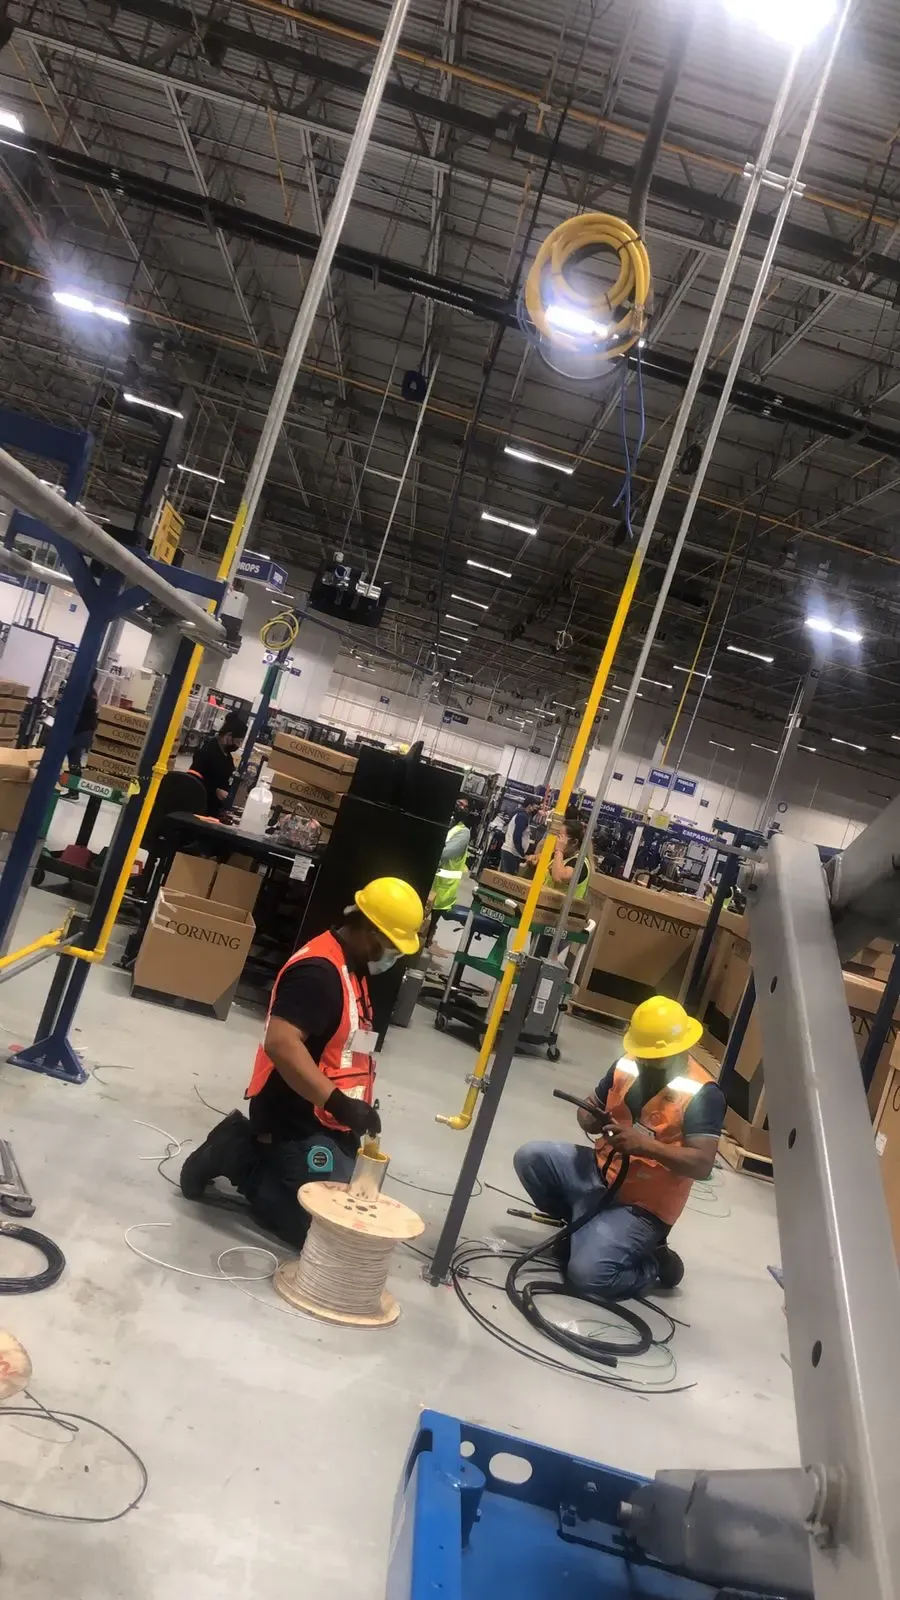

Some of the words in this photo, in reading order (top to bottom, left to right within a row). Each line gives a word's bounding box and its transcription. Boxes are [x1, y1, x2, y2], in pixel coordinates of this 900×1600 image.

[238, 561, 261, 574] ROPS
[290, 741, 330, 761] CORNING
[80, 780, 110, 796] CALIDAD
[493, 877, 527, 895] CORNING
[616, 906, 692, 939] CORNING
[166, 920, 241, 950] CORNING
